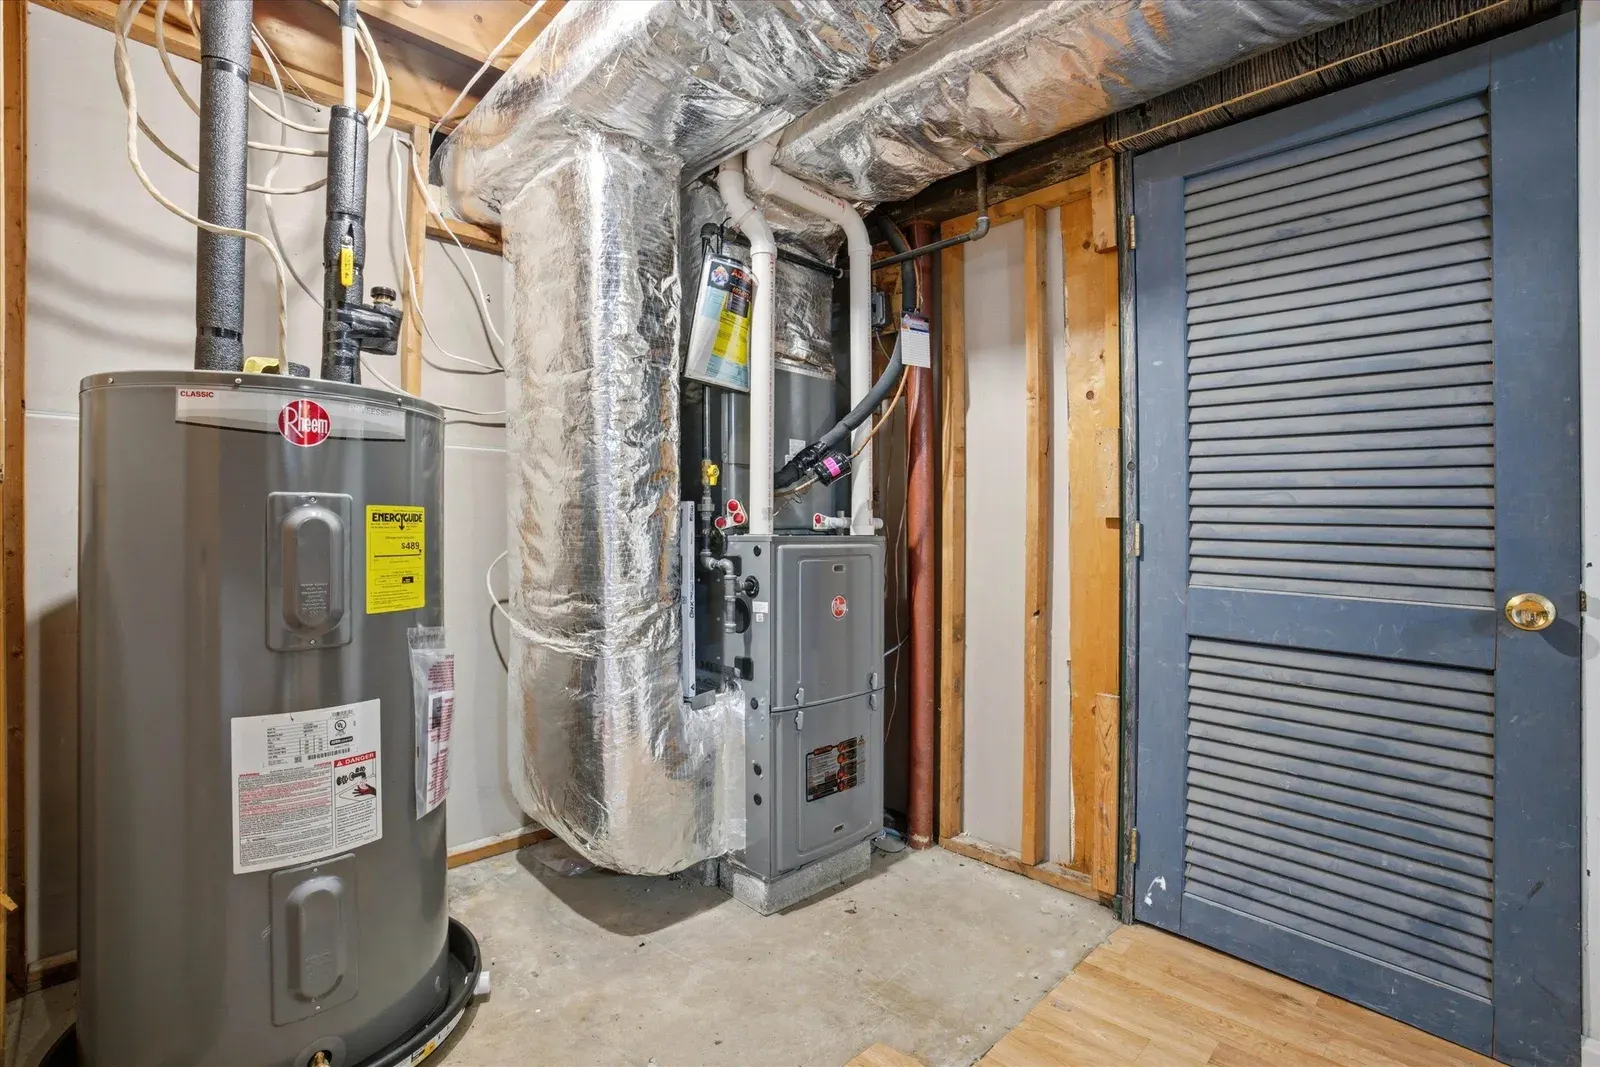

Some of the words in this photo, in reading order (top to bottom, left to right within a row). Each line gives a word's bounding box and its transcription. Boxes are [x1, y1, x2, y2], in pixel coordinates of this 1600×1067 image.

[180, 390, 214, 398] CLASSIC
[285, 400, 328, 438] Rheem
[401, 541, 420, 550] $489
[345, 752, 375, 765] DANGER
